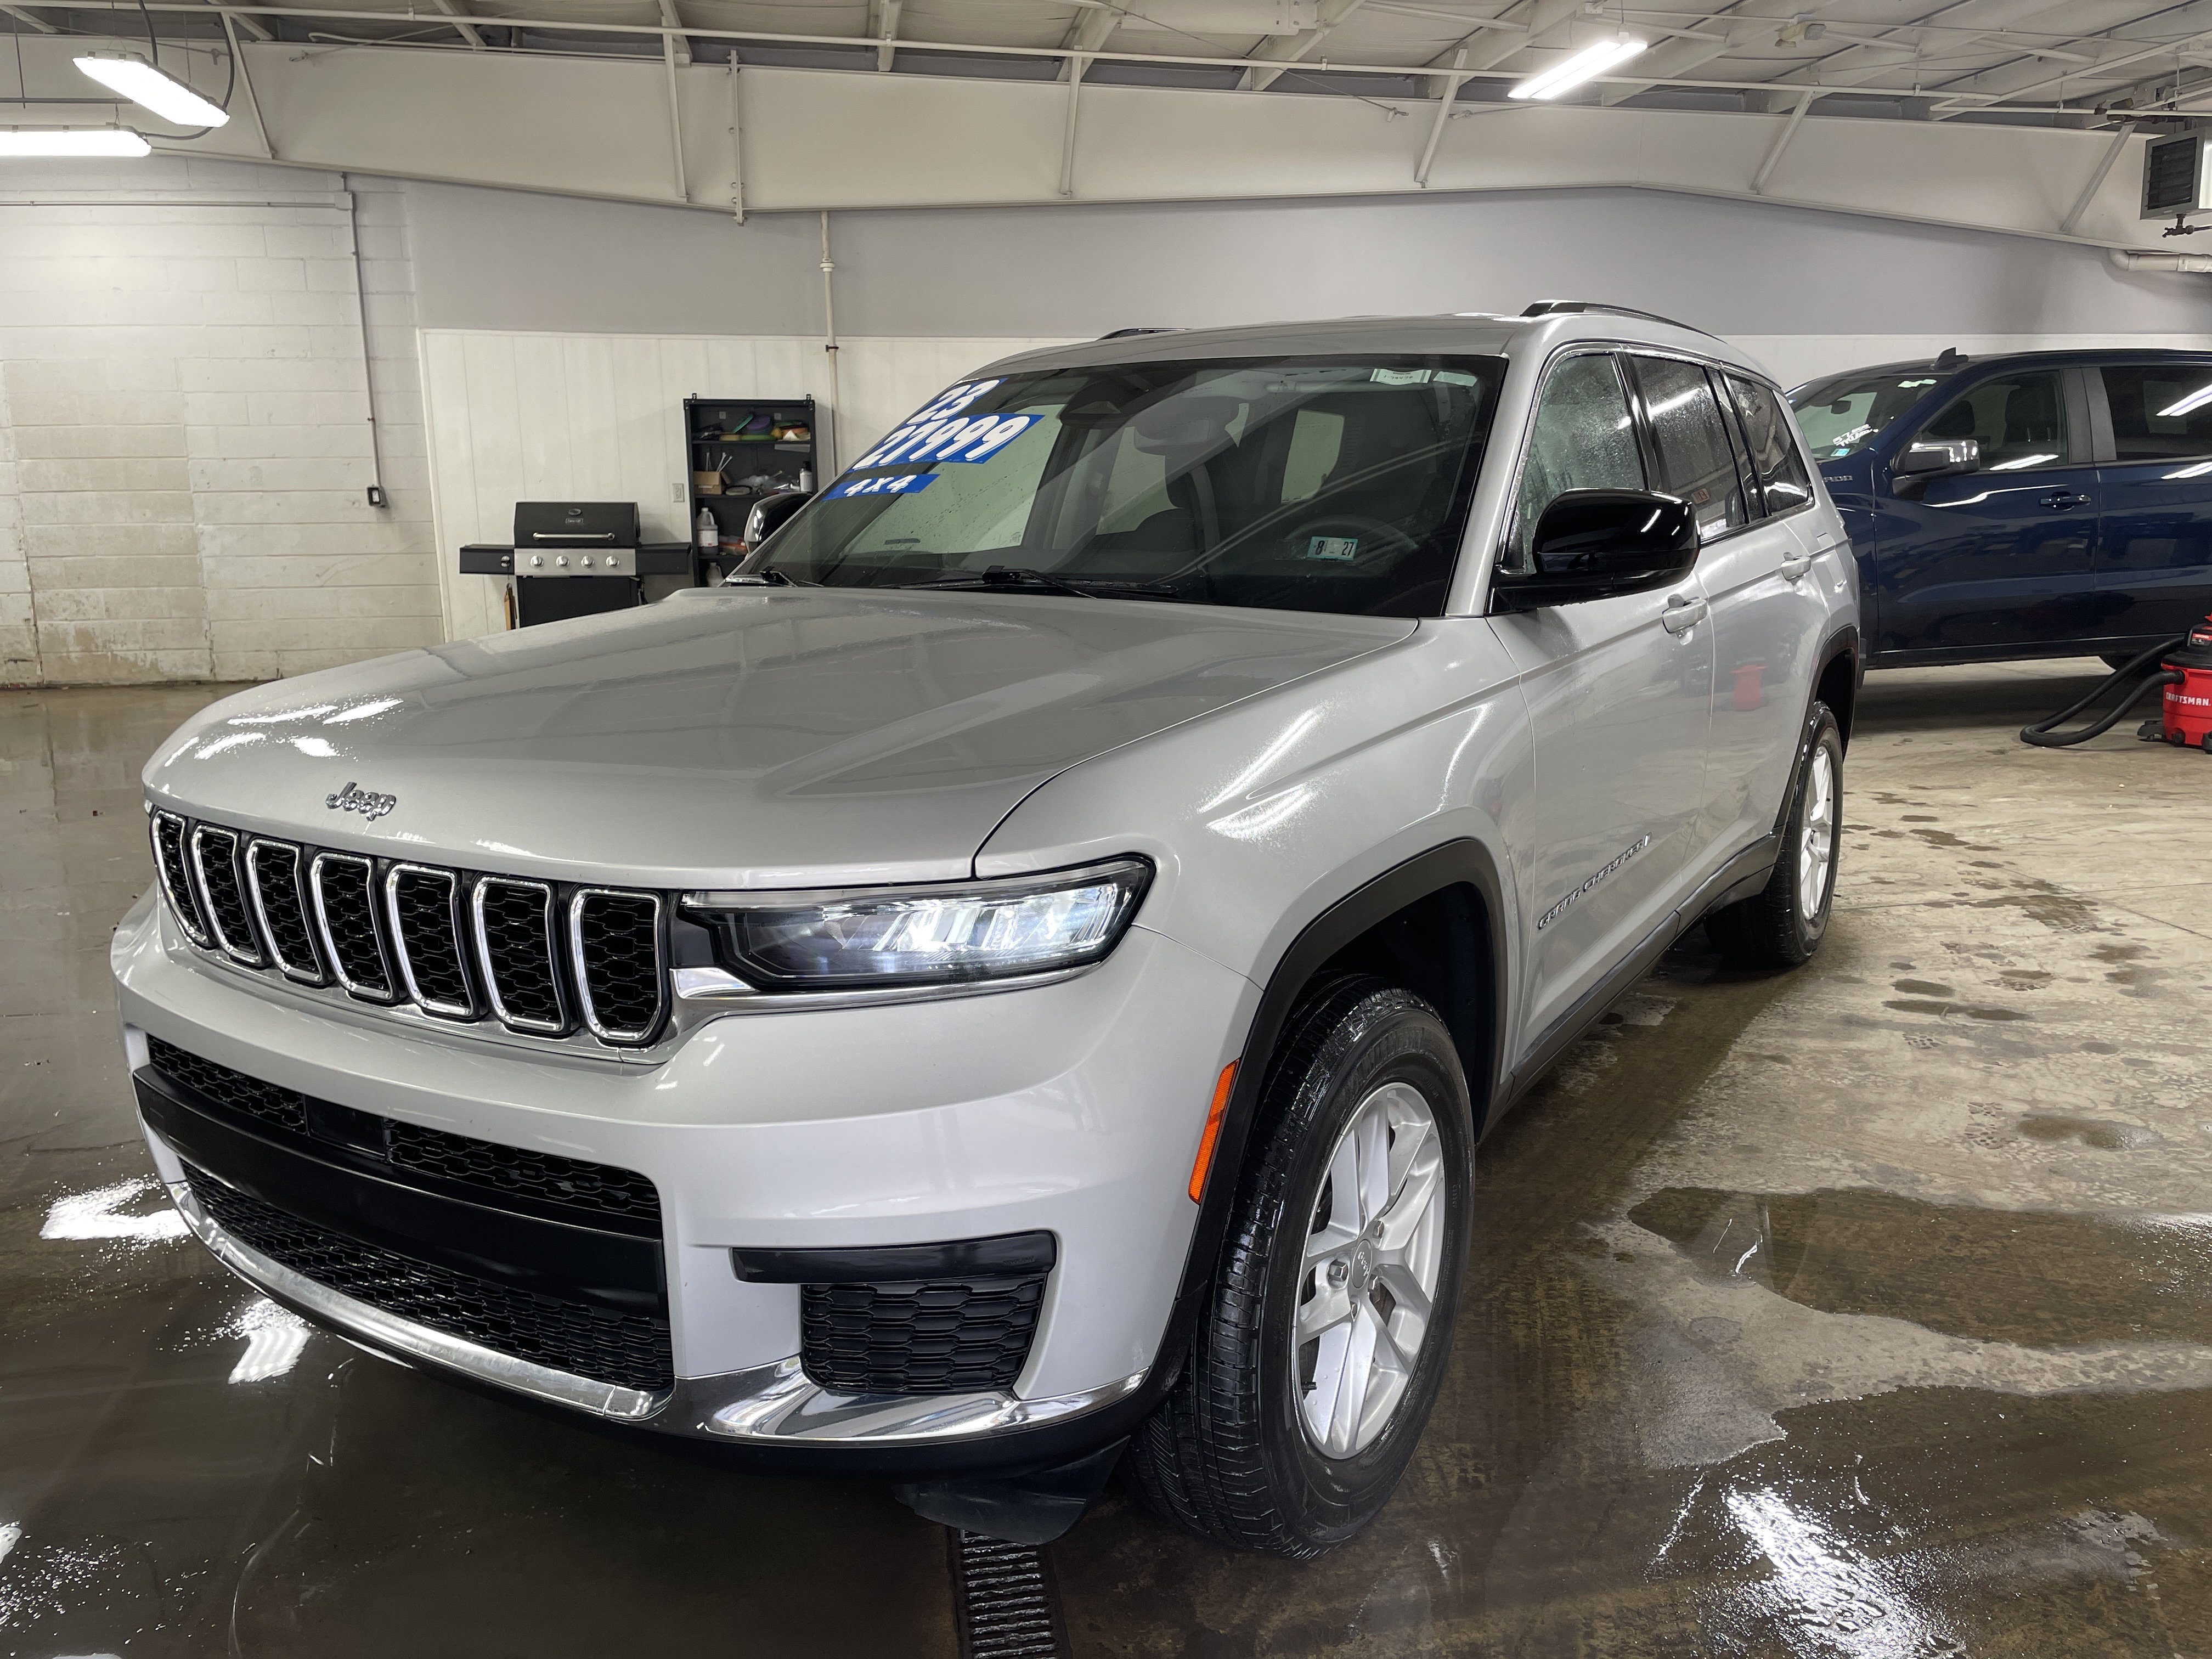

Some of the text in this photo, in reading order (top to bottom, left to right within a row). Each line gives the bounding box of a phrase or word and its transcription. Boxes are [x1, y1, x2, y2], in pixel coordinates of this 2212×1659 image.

[907, 379, 1000, 425] 23
[853, 415, 1030, 470] 27999
[1315, 540, 1355, 557] 8 27
[2166, 692, 2209, 706] CRAFTSMAN
[325, 781, 396, 821] Jeep
